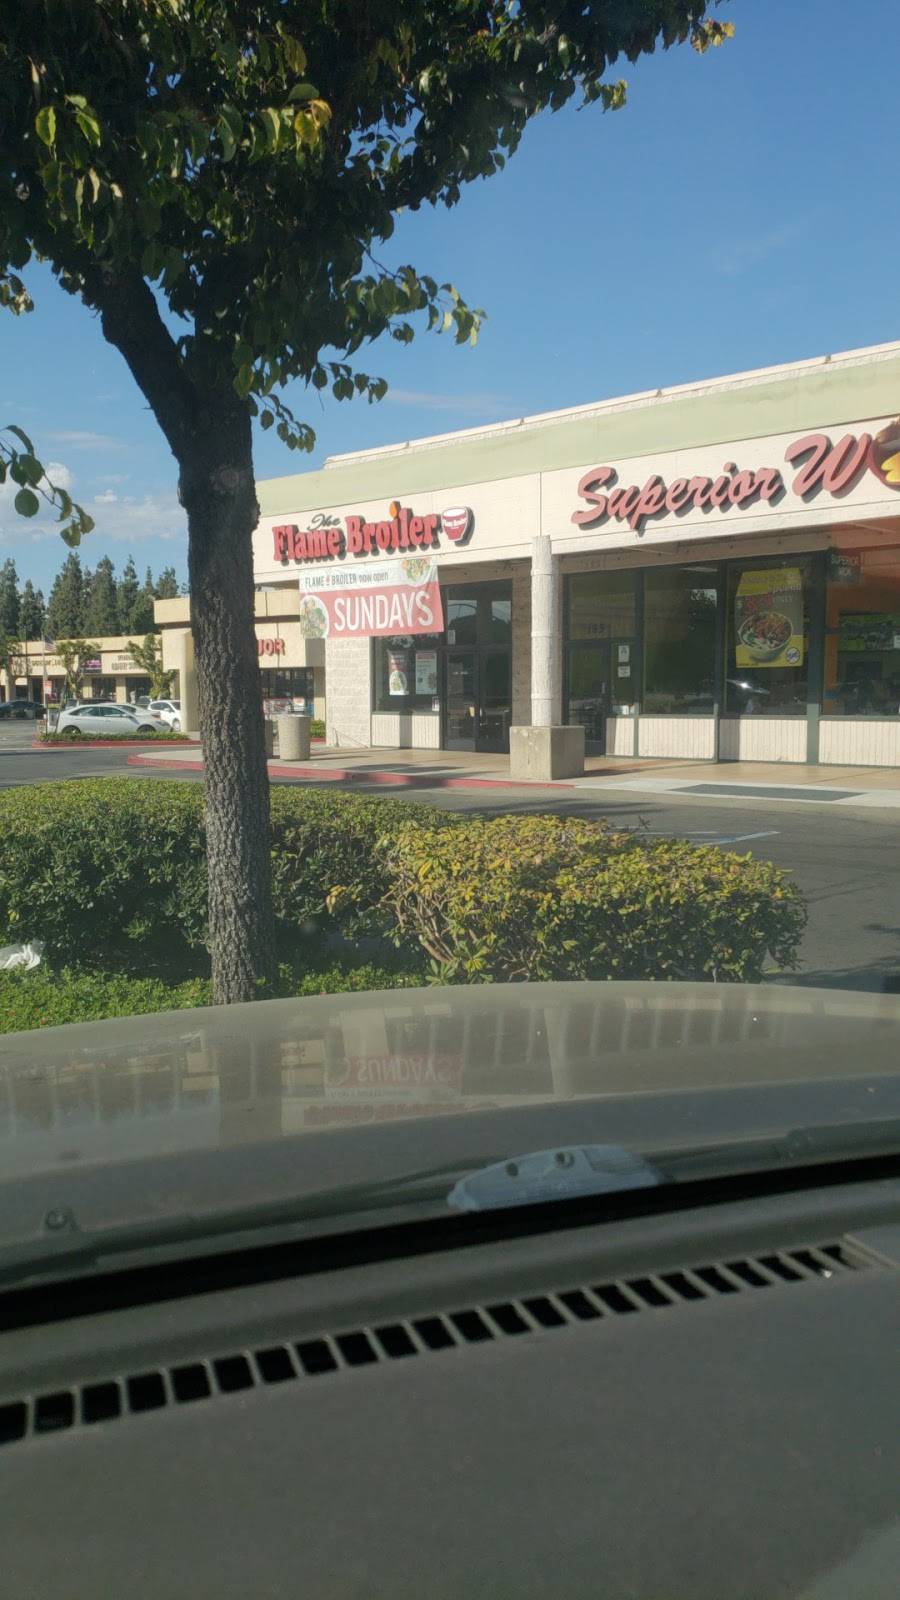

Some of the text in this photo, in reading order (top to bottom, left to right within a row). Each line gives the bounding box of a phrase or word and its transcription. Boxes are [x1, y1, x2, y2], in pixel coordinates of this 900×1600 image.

[571, 462, 784, 531] Superior
[272, 504, 439, 563] Flame Broiler
[307, 513, 341, 531] The
[305, 576, 324, 588] FLAME
[331, 572, 358, 586] BROILER
[334, 591, 433, 631] SUNDAYS
